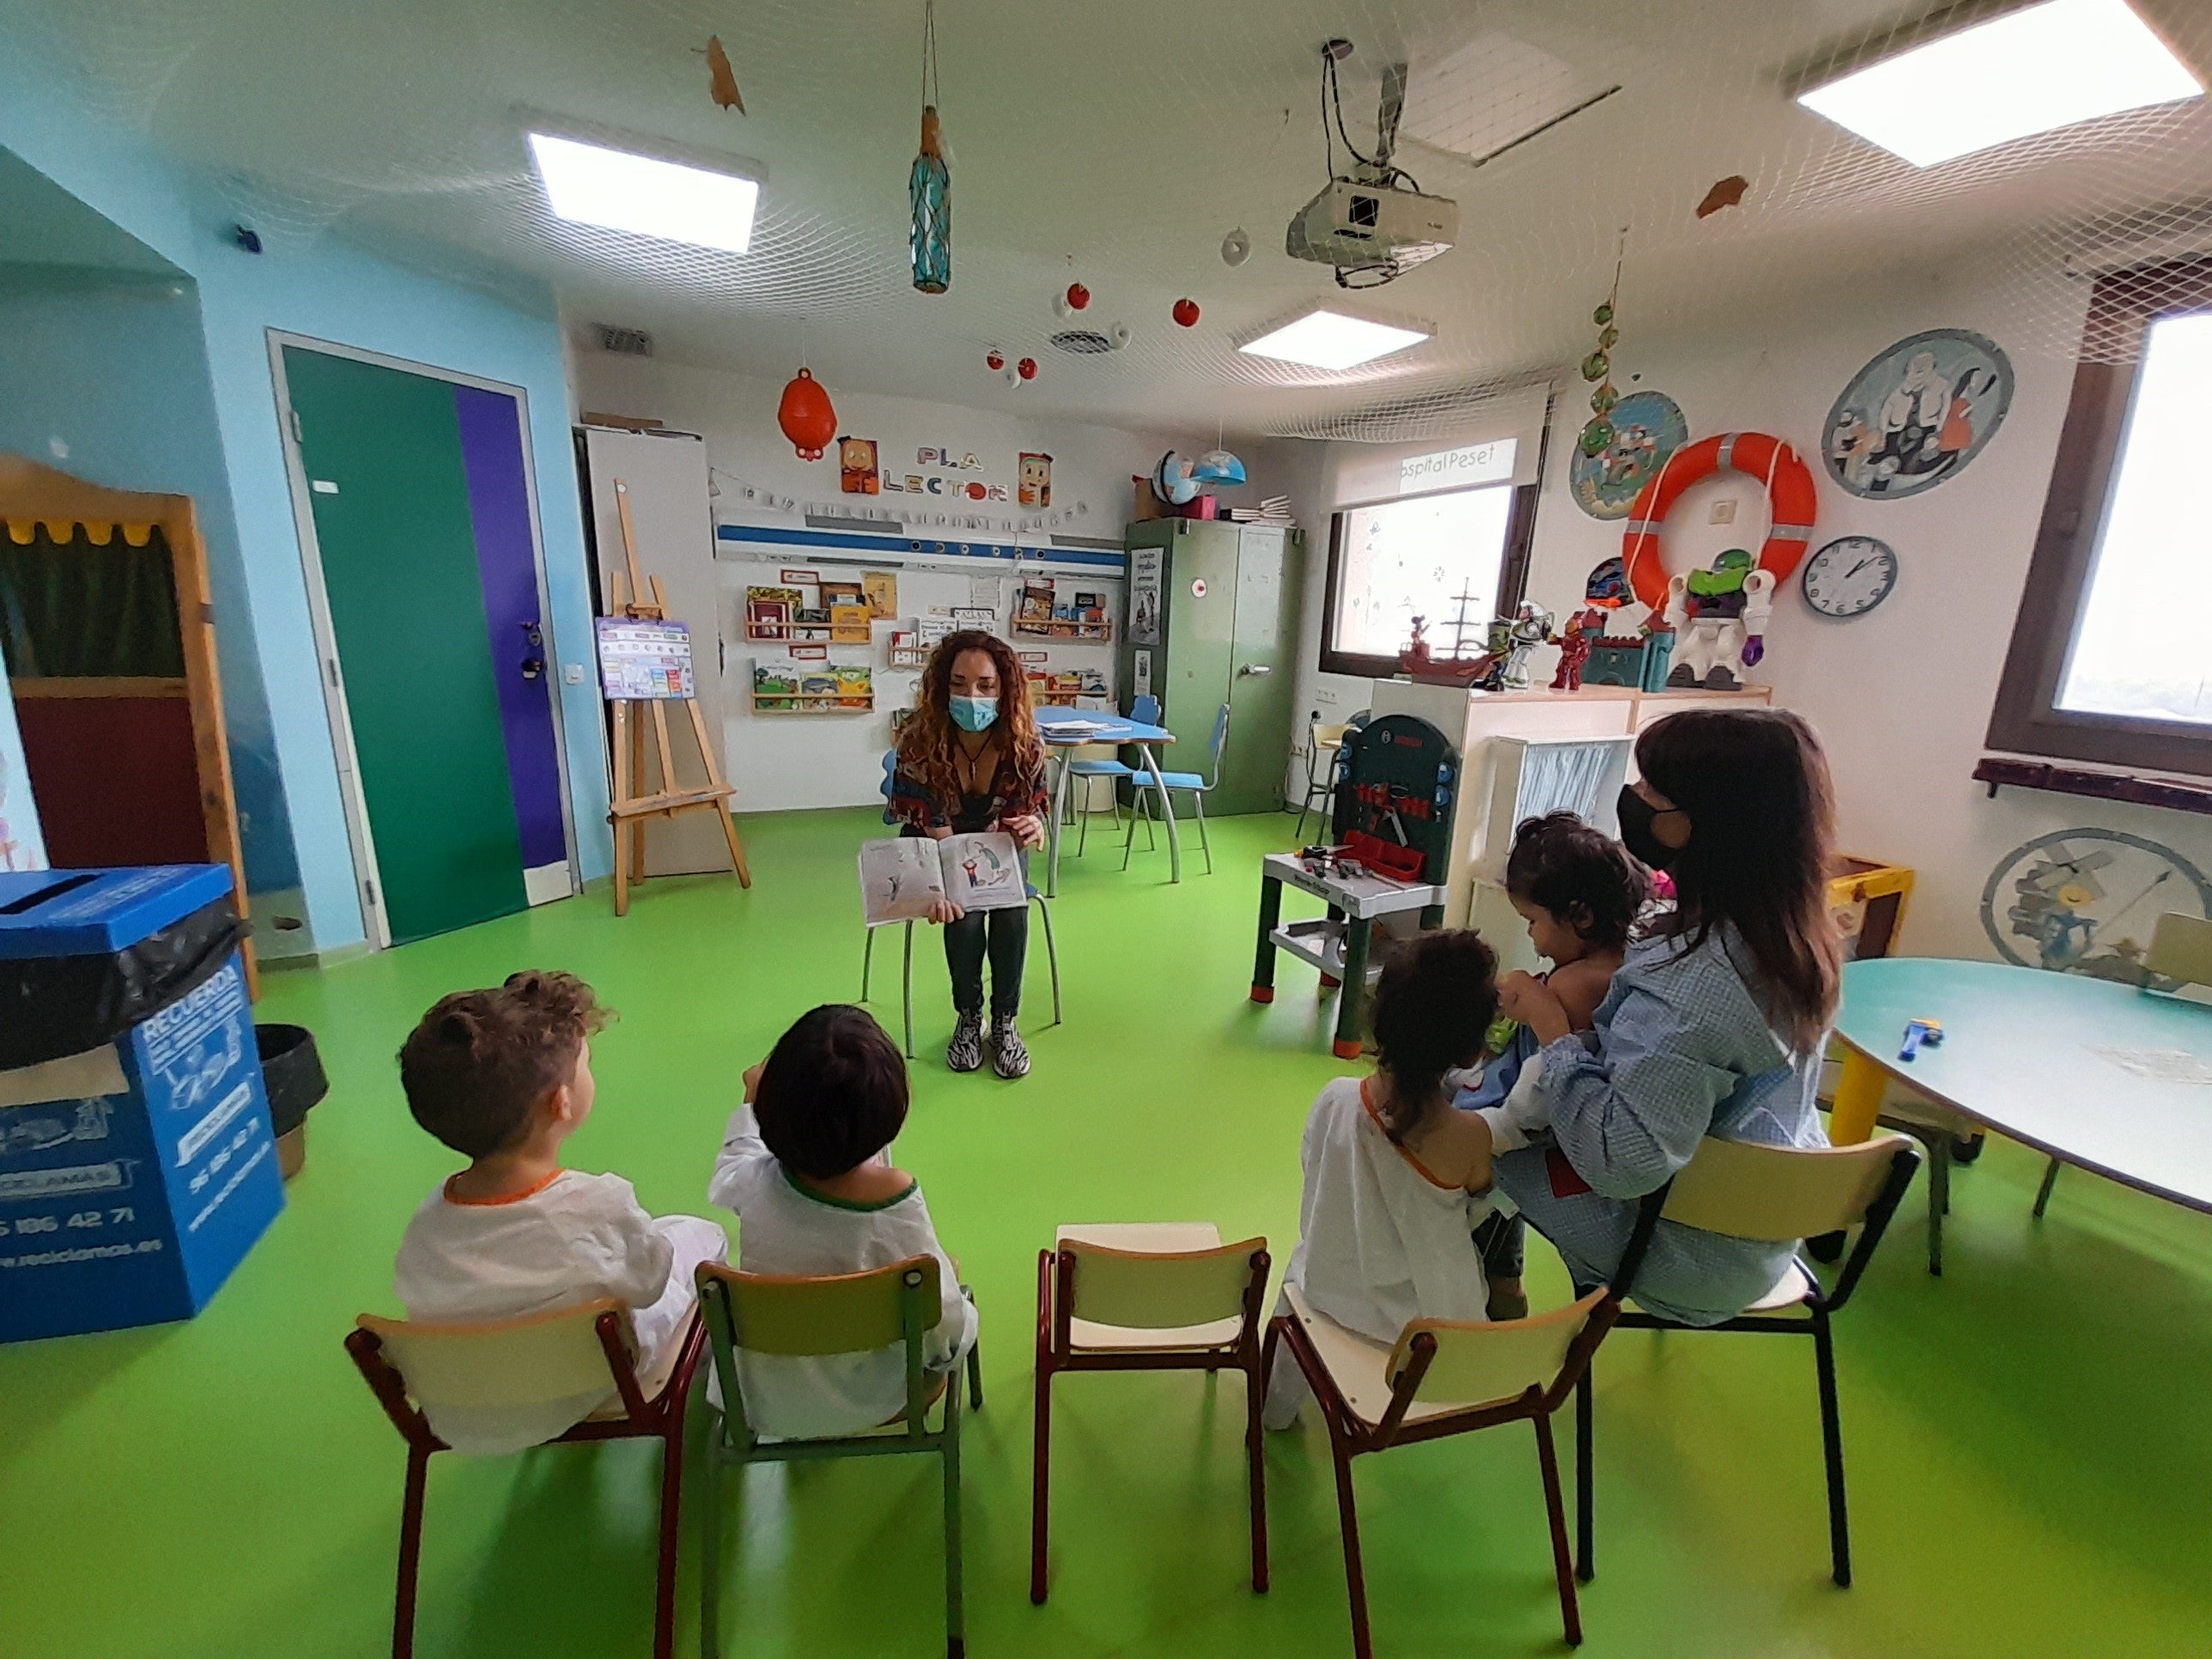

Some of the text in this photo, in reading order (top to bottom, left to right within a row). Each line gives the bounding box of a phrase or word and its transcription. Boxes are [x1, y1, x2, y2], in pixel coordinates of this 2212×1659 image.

[917, 447, 982, 471] PLA
[883, 470, 1008, 501] LECTOR
[142, 964, 238, 1042] RECUERDA
[66, 1211, 104, 1229] 42
[109, 1206, 136, 1224] 71
